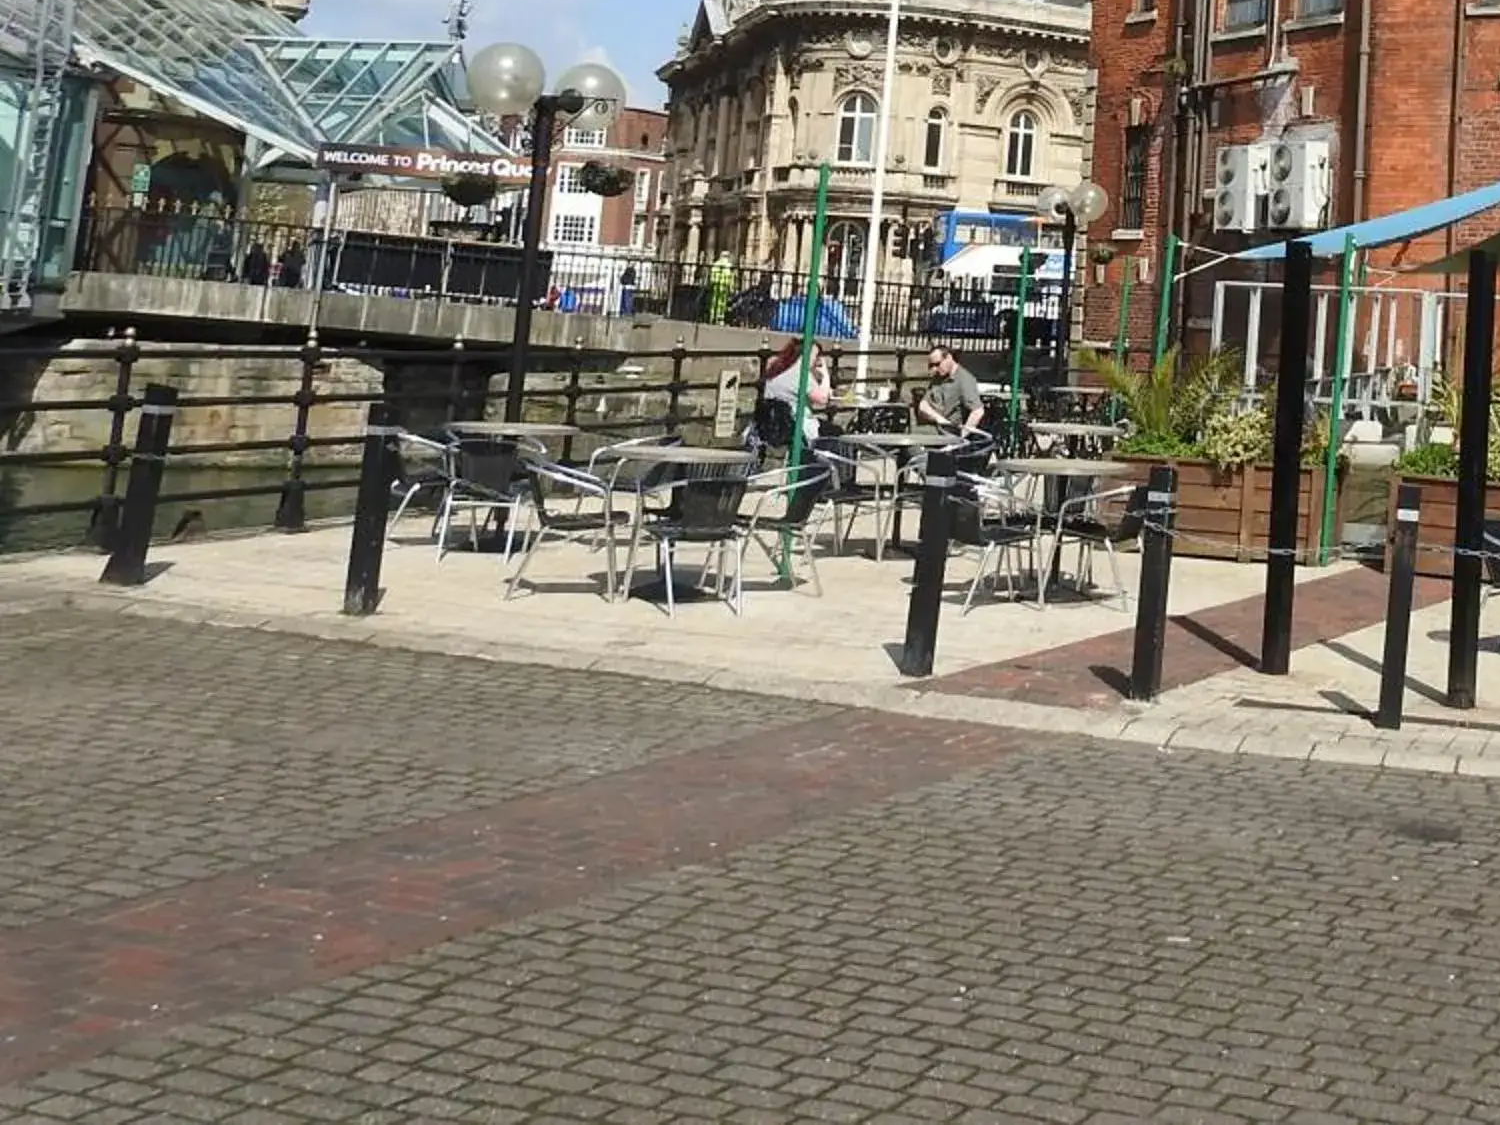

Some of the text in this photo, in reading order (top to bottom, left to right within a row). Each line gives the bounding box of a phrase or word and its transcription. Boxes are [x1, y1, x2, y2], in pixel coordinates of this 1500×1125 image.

[322, 150, 390, 167] WELCOME
[393, 154, 412, 168] TO
[416, 152, 491, 175] Princes
